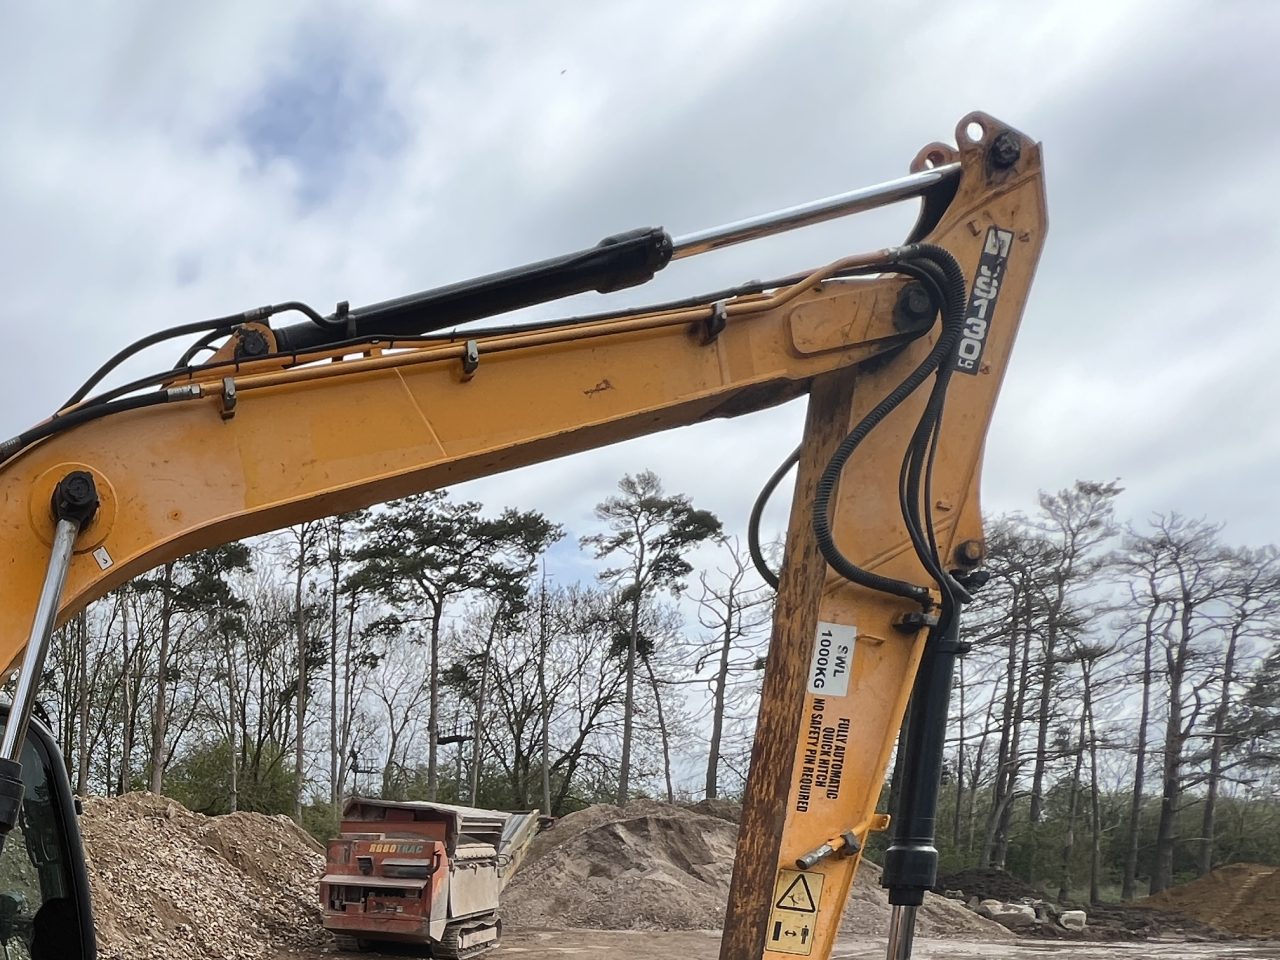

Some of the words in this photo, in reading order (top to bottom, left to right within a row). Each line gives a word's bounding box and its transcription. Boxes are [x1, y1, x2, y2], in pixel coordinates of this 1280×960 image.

[814, 630, 832, 688] 1000KG
[833, 645, 849, 677] SWL
[812, 698, 825, 712] NO
[807, 713, 823, 747] SAFETY
[820, 727, 835, 757] QUICK
[836, 717, 850, 744] FULLY
[804, 748, 817, 765] PIN
[815, 759, 830, 788] HITCH
[826, 745, 845, 800] AUTOMATIC
[796, 766, 814, 812] REQUIRED
